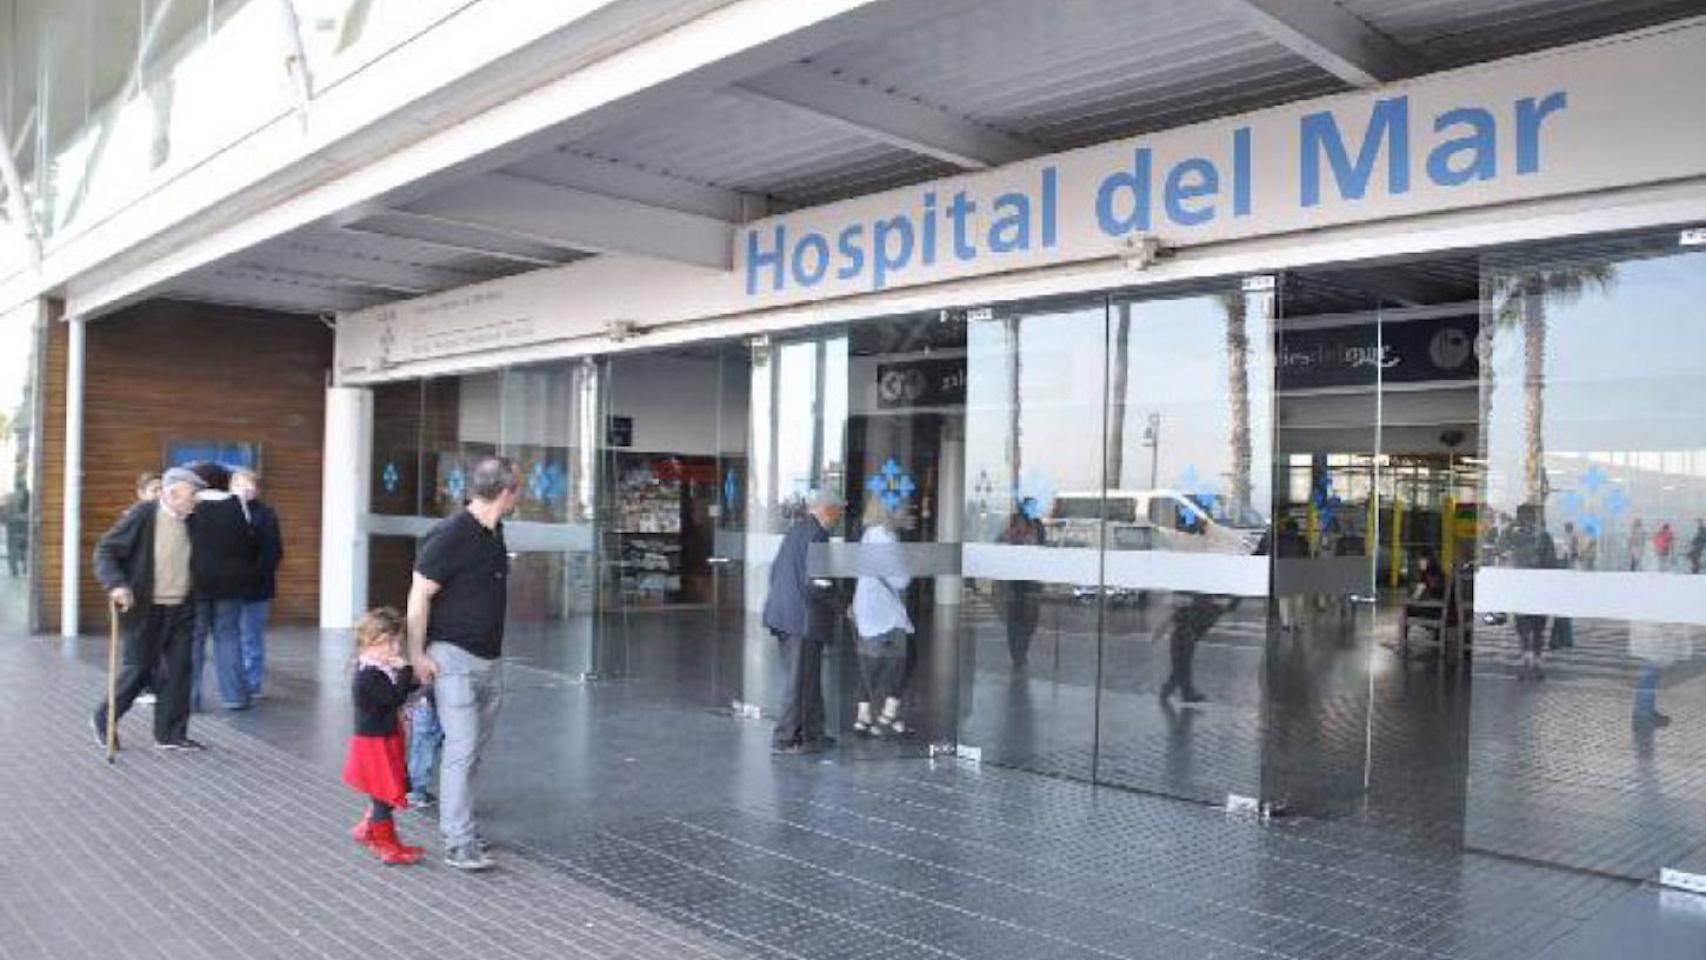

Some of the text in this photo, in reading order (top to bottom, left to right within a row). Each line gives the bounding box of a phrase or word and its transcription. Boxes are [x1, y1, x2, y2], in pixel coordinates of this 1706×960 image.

[746, 91, 1567, 295] Hospital del Mar
